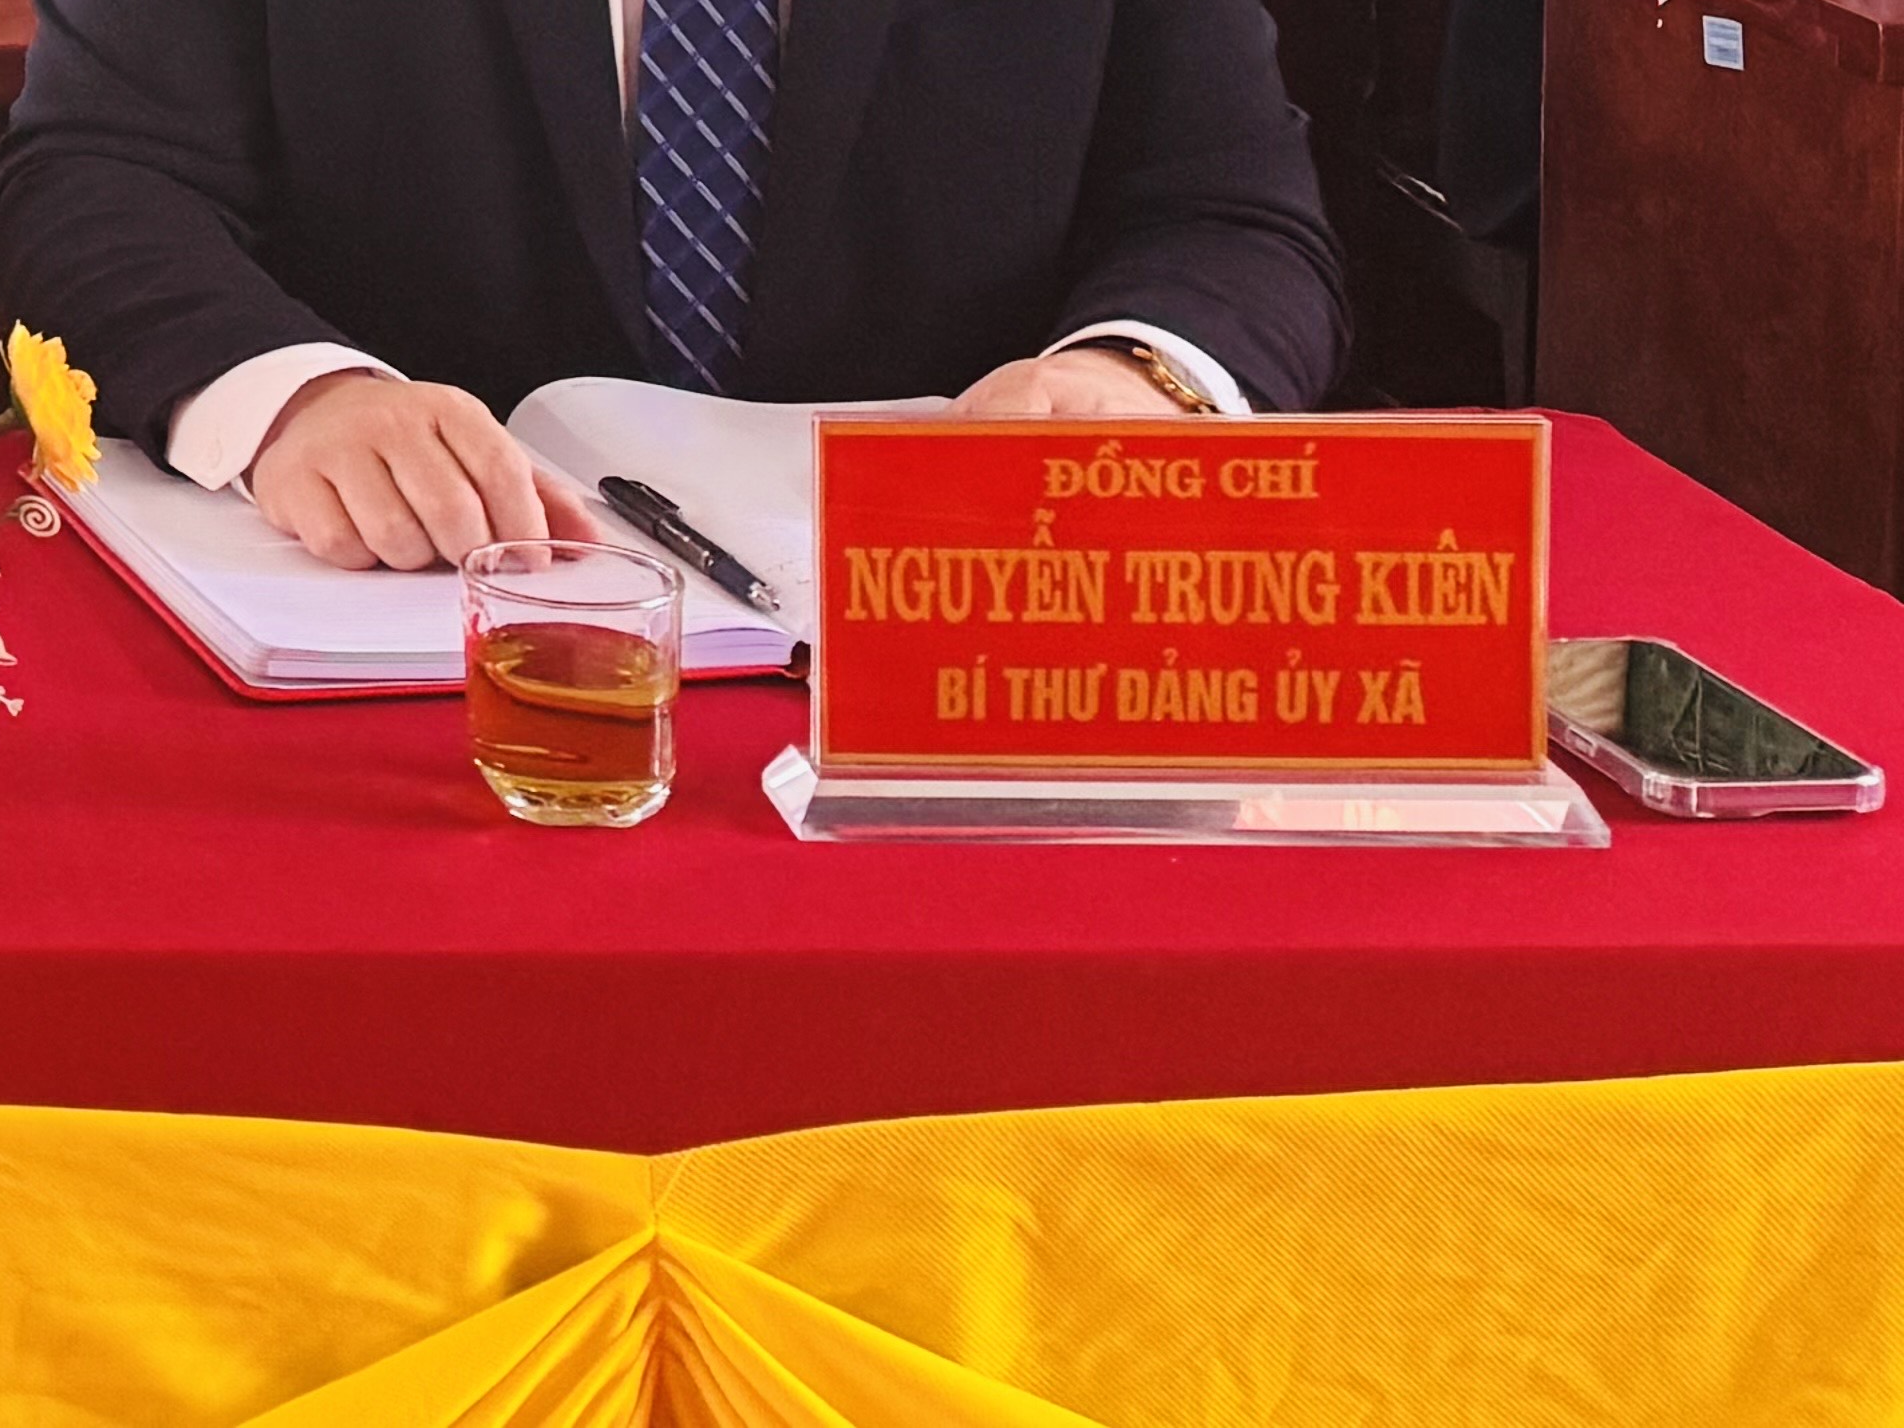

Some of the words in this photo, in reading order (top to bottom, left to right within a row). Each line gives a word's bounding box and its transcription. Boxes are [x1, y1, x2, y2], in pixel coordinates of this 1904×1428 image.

[1044, 440, 1206, 498] ĐỒNG
[1220, 442, 1318, 499] CHÍ
[844, 508, 1110, 623] NGUYỄN
[1126, 550, 1340, 625] TRUNG
[1355, 529, 1514, 625] KIÊN
[938, 655, 987, 720] BÍ
[1003, 663, 1107, 721] THƯ
[1117, 648, 1257, 722] ĐẢNG
[1358, 659, 1425, 724] XÃ
